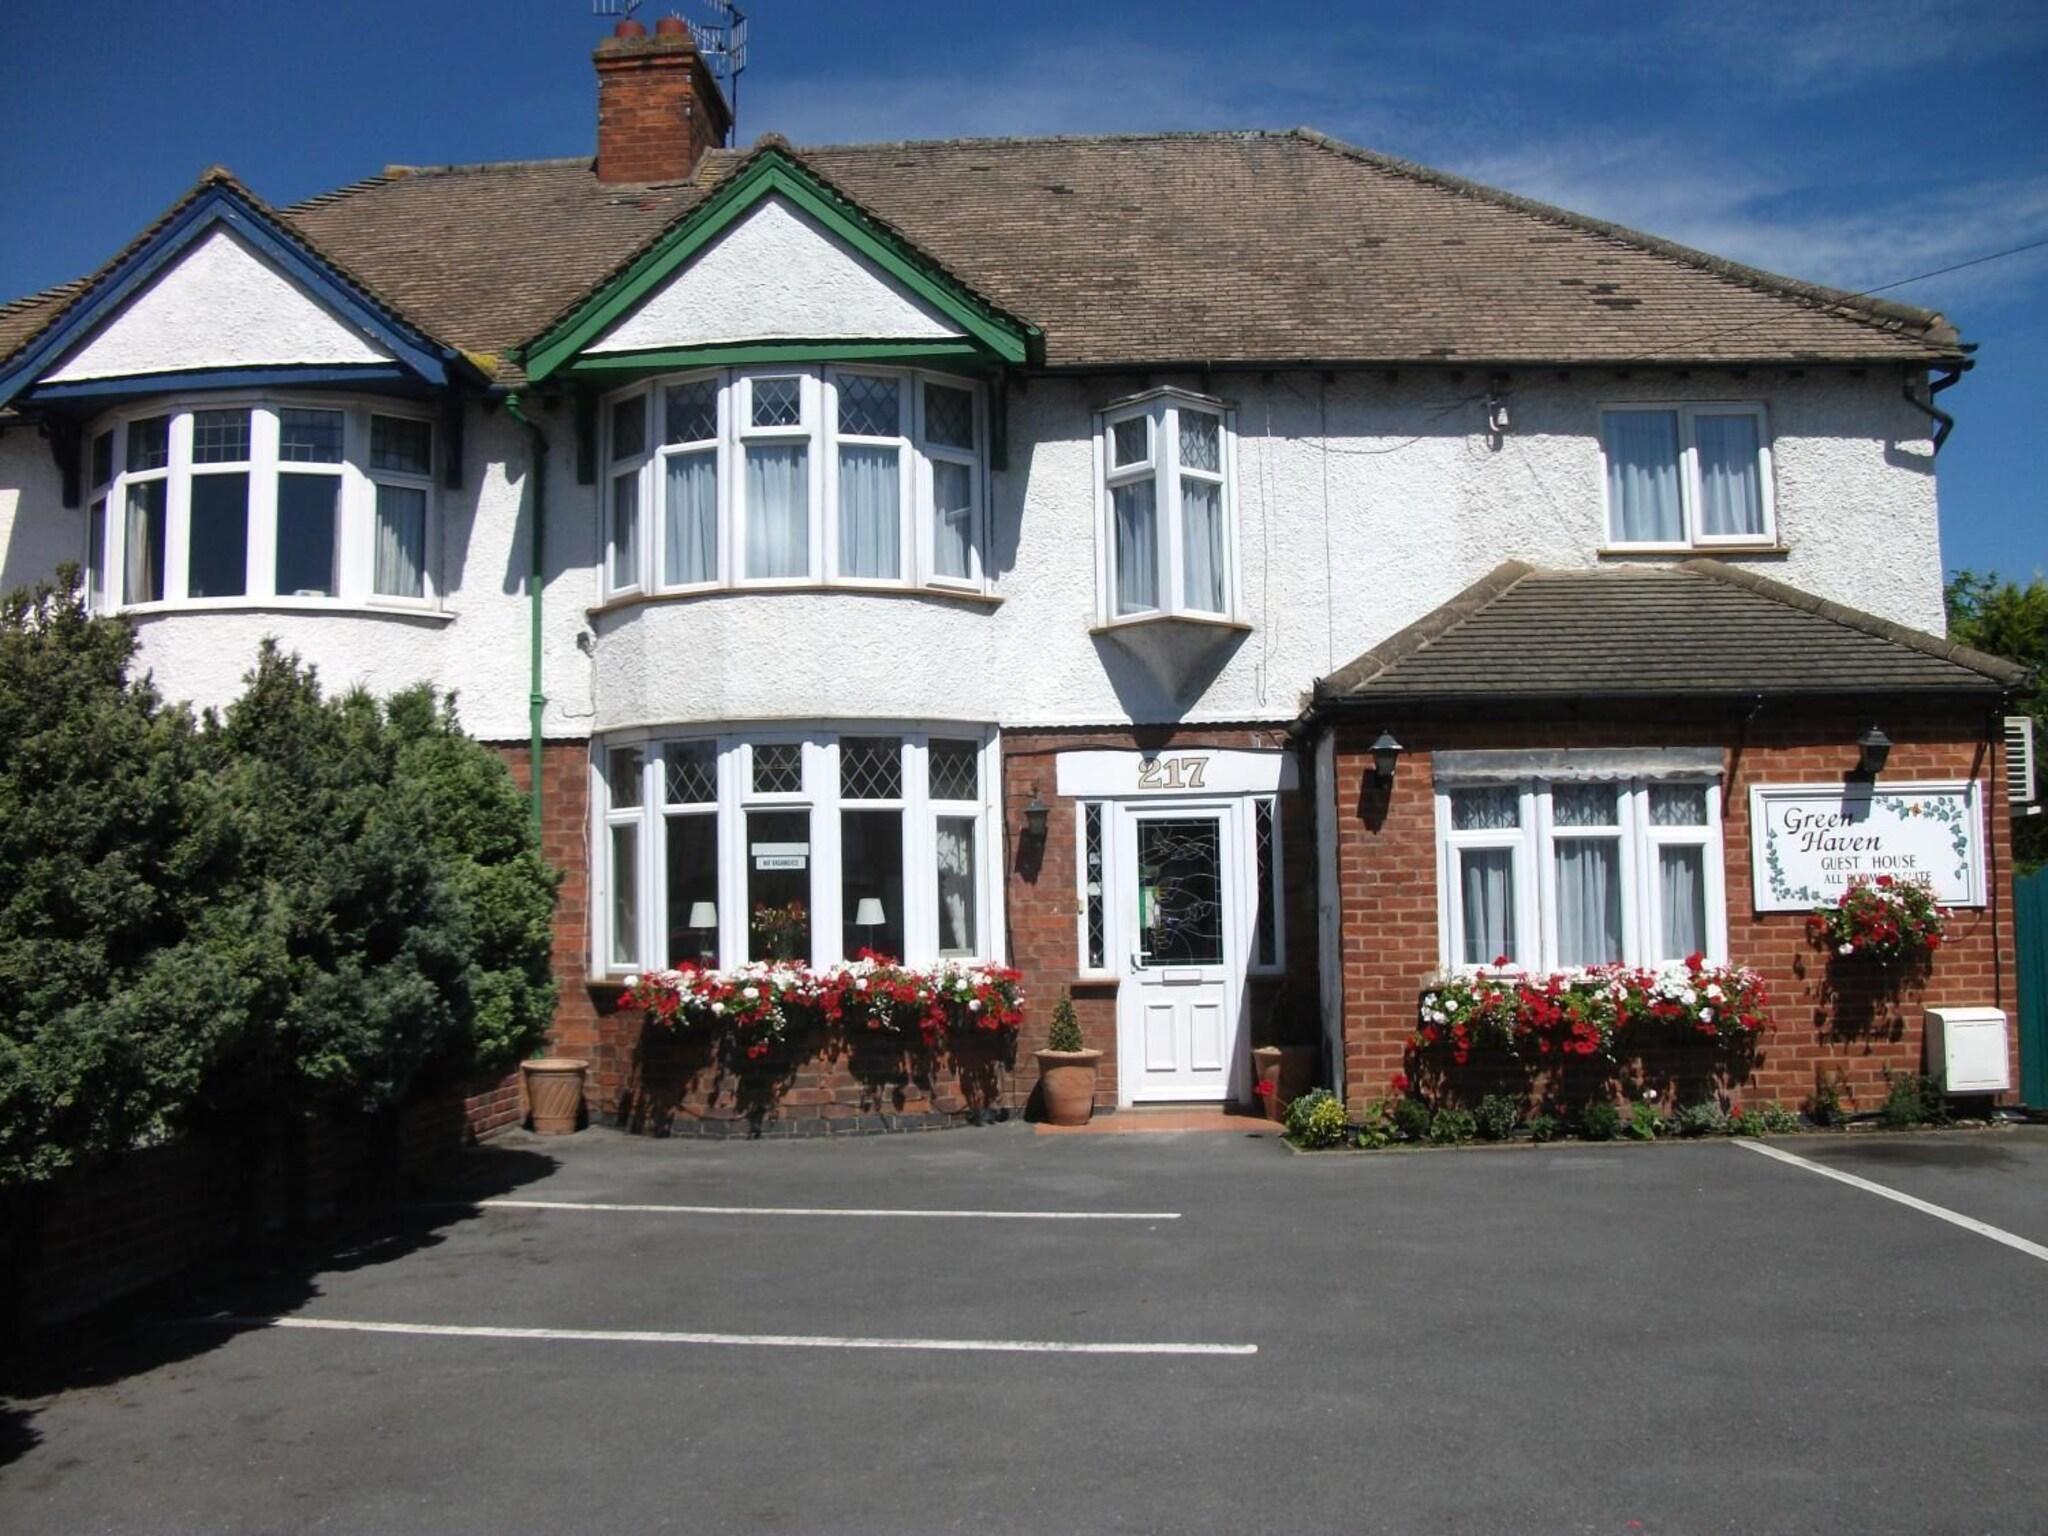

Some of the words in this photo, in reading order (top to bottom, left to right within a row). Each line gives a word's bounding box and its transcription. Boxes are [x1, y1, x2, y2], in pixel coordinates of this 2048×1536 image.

[1138, 757, 1210, 789] 217
[1784, 807, 1855, 834] Green
[1800, 829, 1882, 852] Haven
[1820, 856, 1860, 870] GUEST
[1872, 854, 1917, 869] HOUSE
[1823, 873, 1843, 884] ALL
